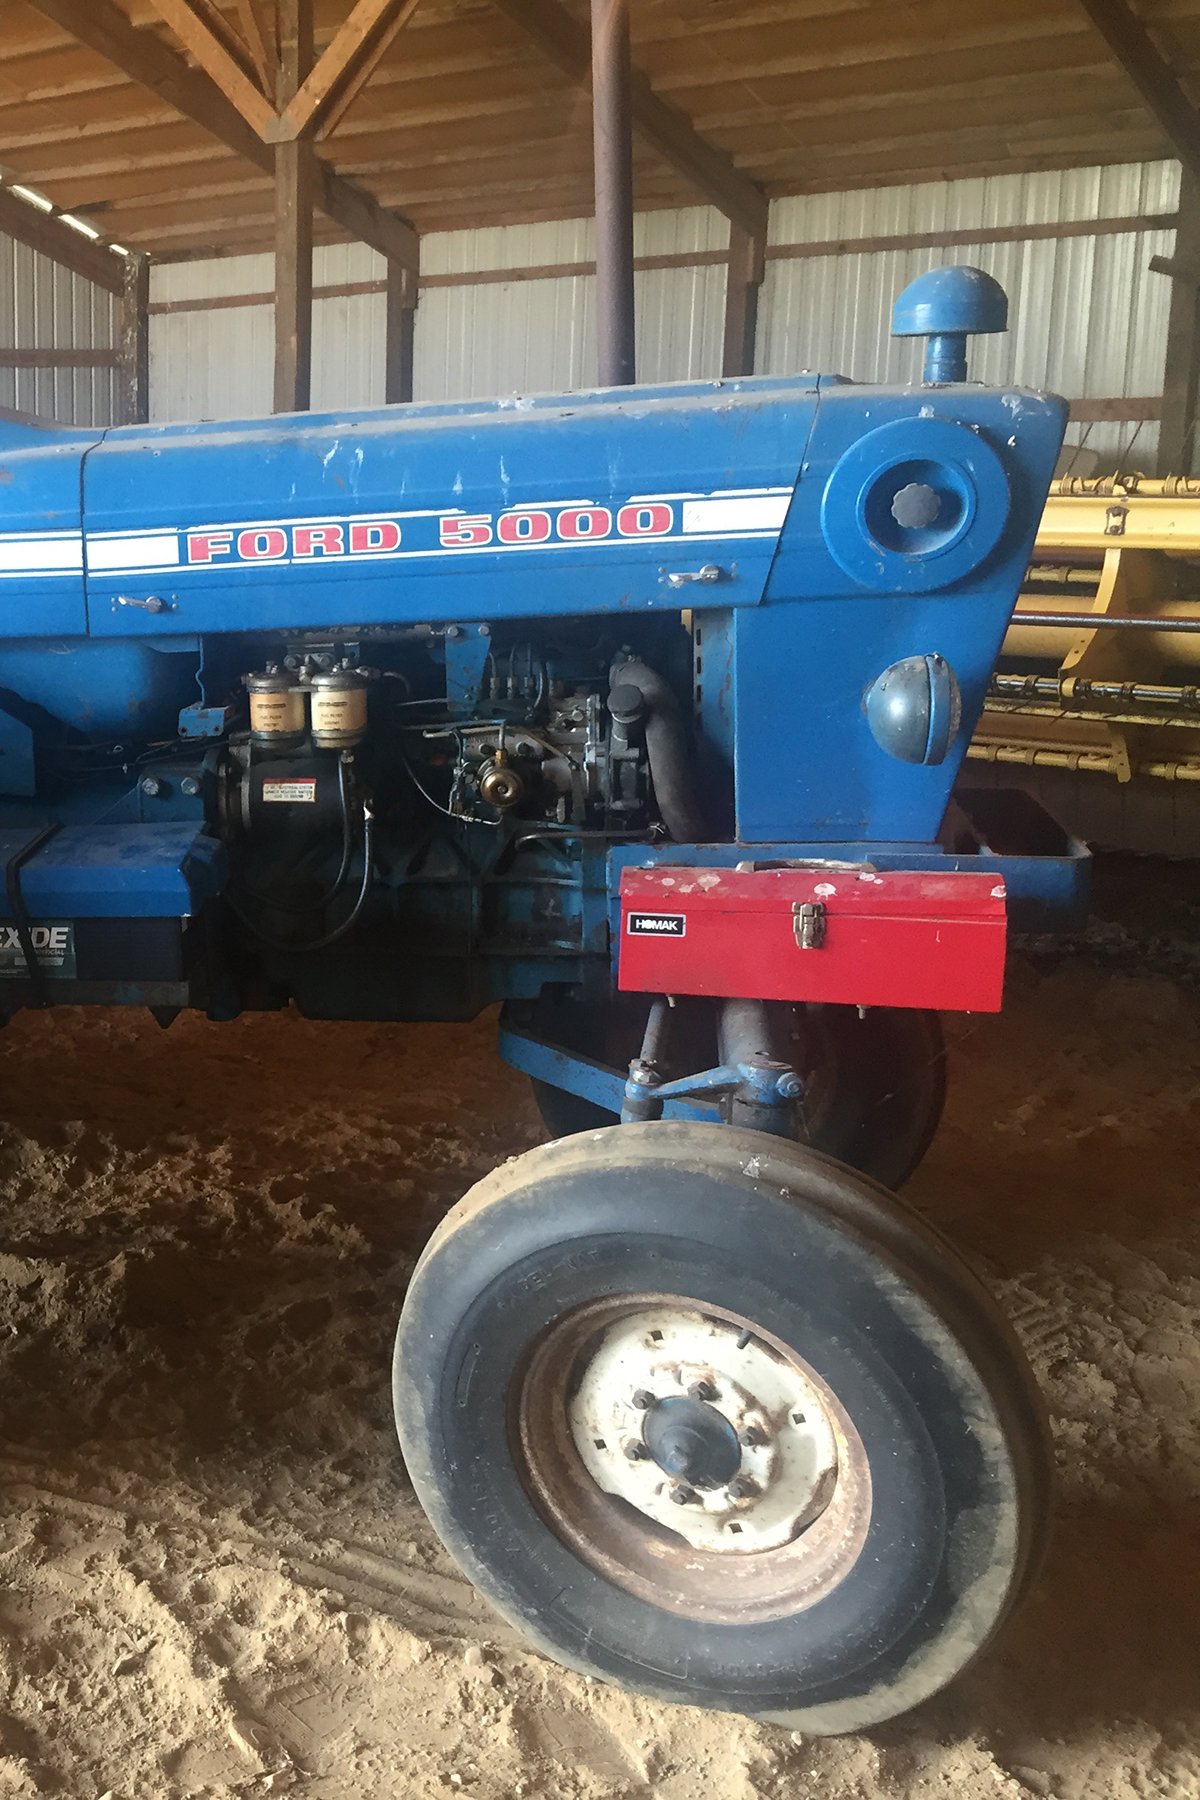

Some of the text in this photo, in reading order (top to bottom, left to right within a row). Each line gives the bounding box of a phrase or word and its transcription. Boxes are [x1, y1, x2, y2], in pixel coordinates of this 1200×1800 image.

[187, 501, 673, 564] FORD 5000
[635, 919, 678, 931] HOMAK
